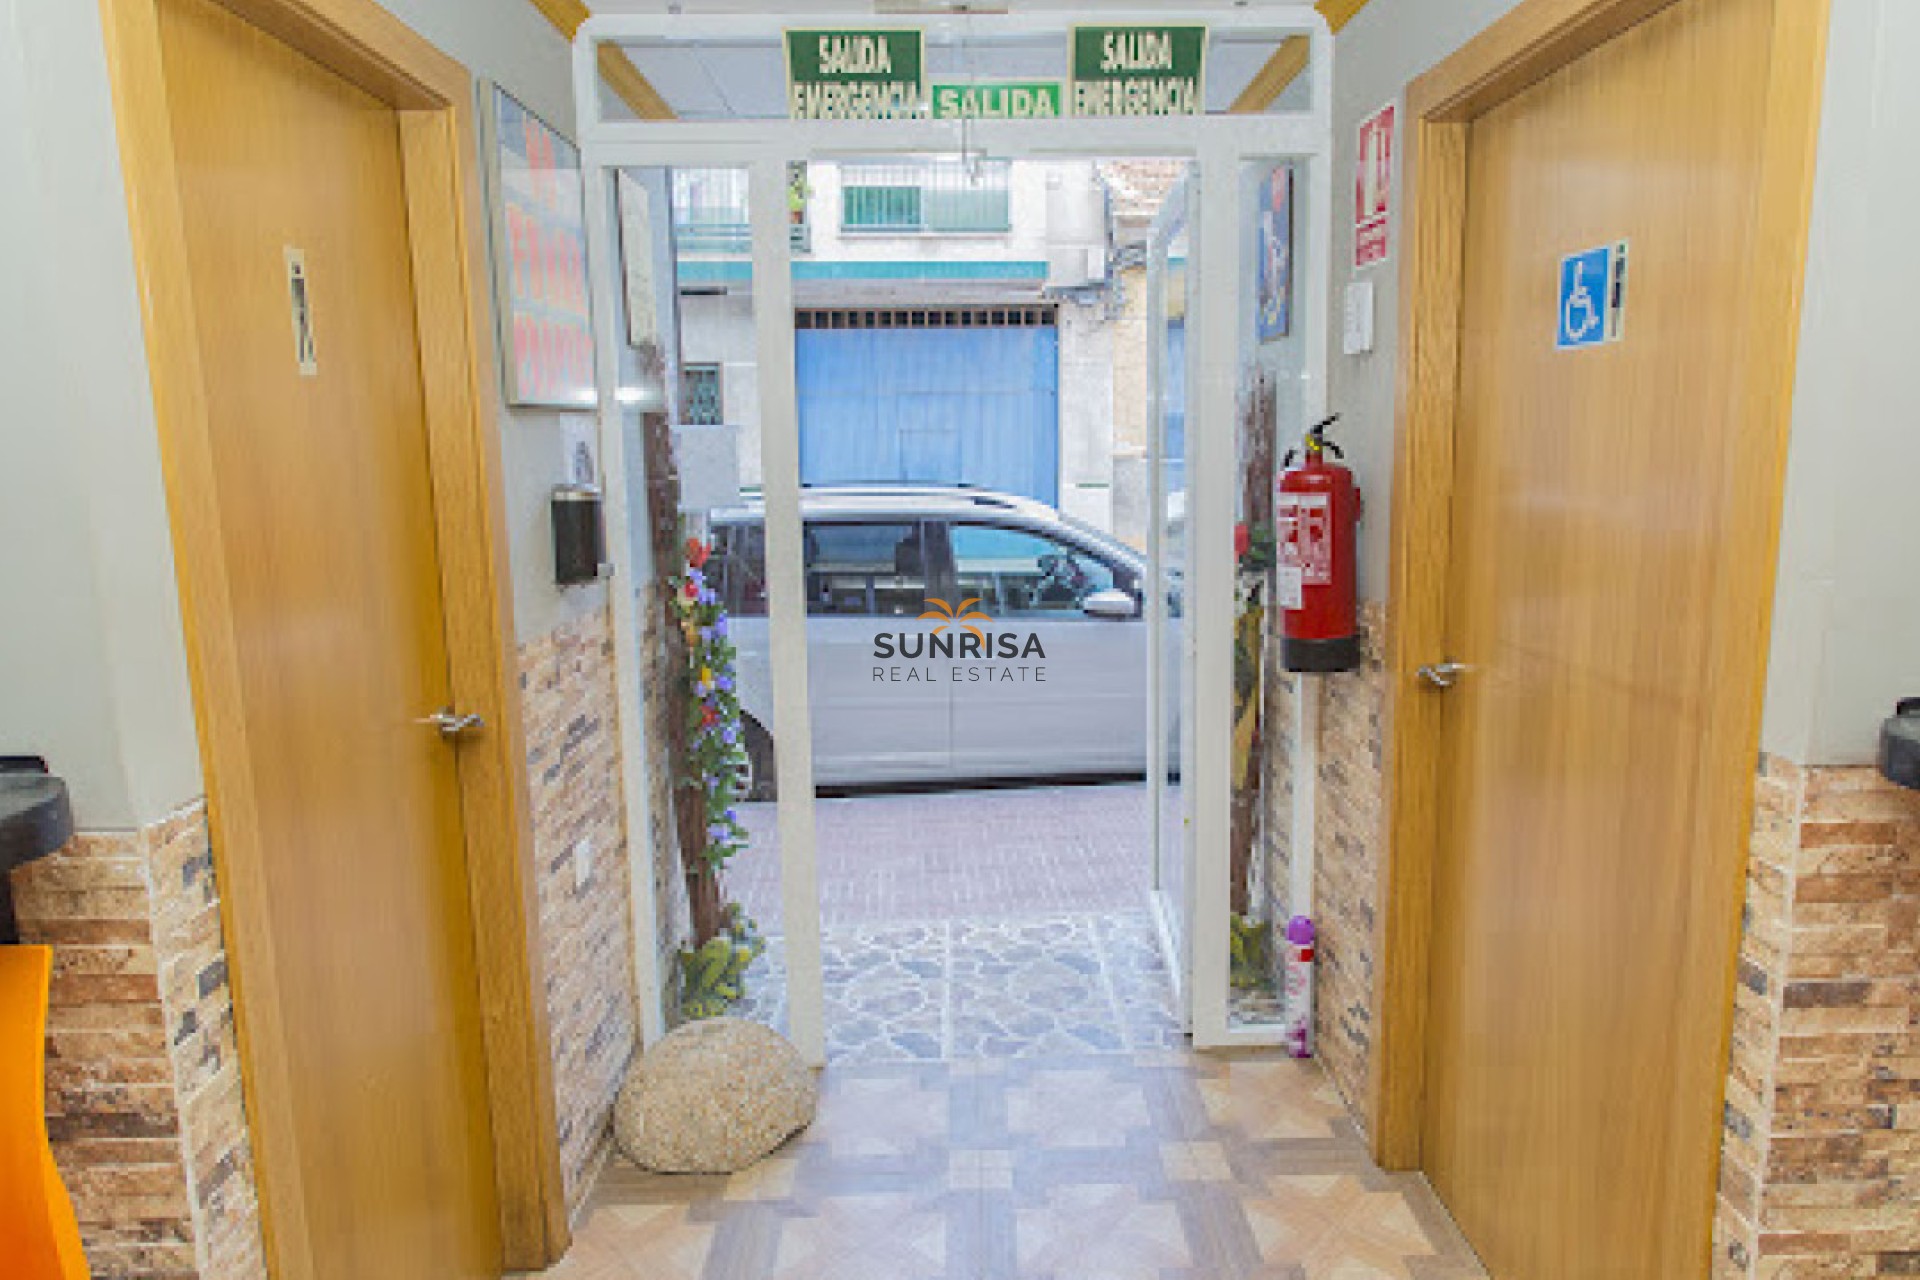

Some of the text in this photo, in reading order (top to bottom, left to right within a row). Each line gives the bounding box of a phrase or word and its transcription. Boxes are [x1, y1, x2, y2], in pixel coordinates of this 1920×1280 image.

[819, 36, 891, 73] SALIDA
[1100, 31, 1172, 72] SALIDA
[794, 81, 924, 119] EMERGENCIA
[940, 89, 1054, 119] SALIDA
[1075, 77, 1199, 116] EMERGENCIA
